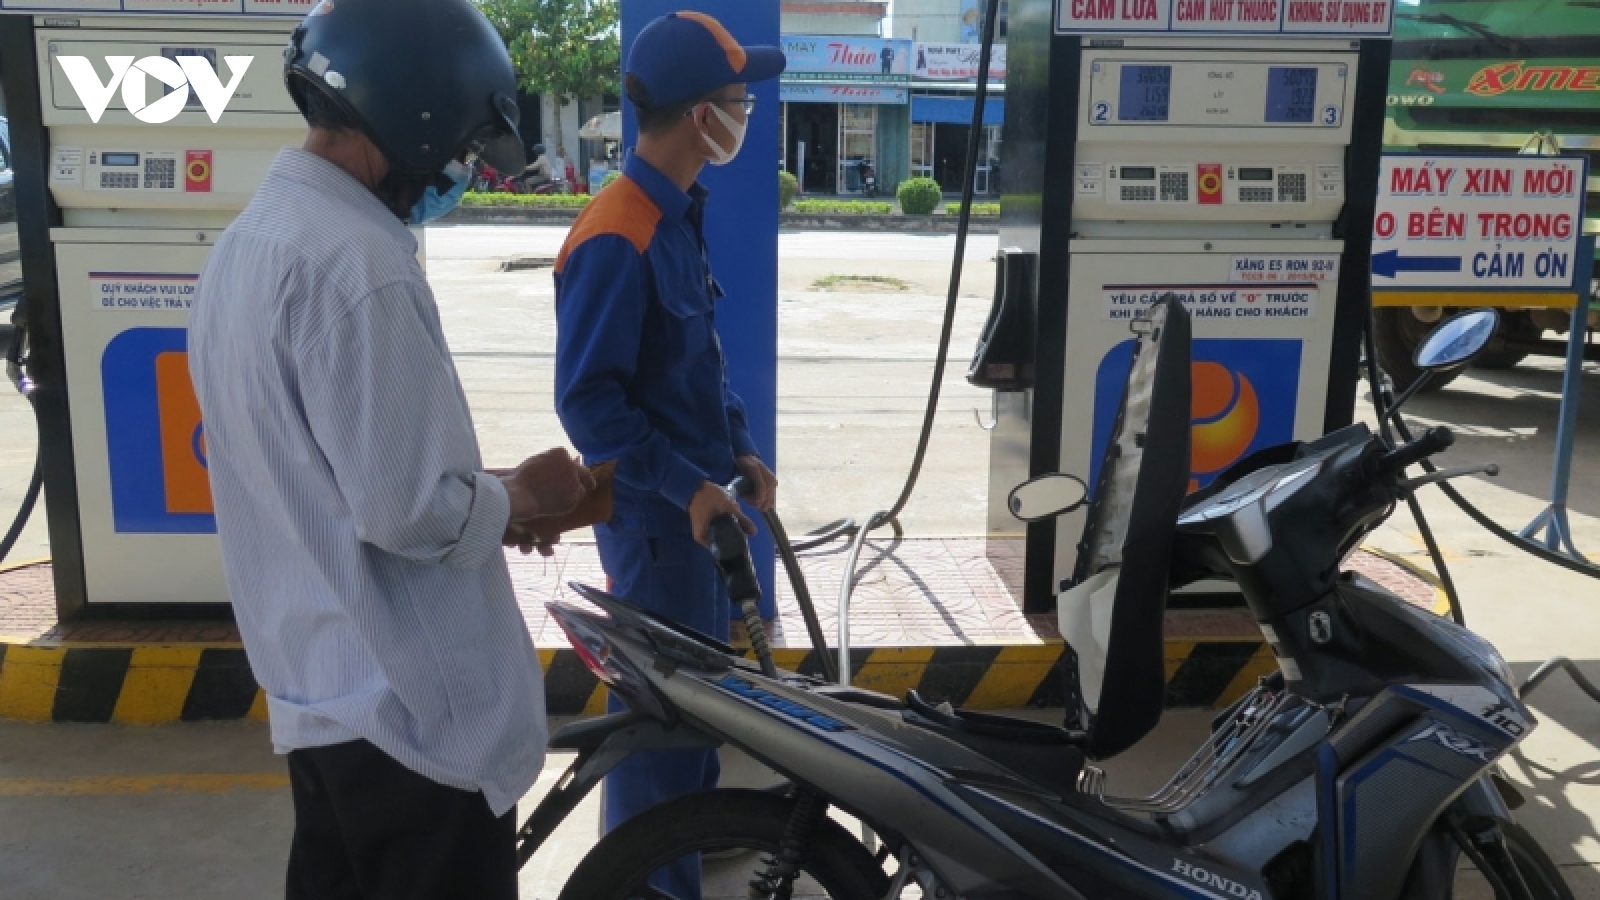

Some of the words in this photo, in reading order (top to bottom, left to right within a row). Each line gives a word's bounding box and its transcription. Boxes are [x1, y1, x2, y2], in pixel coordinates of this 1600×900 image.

[1096, 103, 1108, 121] 2
[1386, 94, 1435, 106] OWO
[1325, 107, 1337, 124] 3
[1463, 168, 1512, 194] XIN
[1524, 162, 1574, 195] MỜI
[1407, 206, 1466, 238] BÊN
[1477, 213, 1572, 239] TRONG
[1472, 243, 1525, 278] CẢM
[1534, 246, 1568, 278] ƠN
[1235, 307, 1262, 317] CHO
[1265, 306, 1309, 317] KHÁCH
[1171, 857, 1263, 900] HONDA
